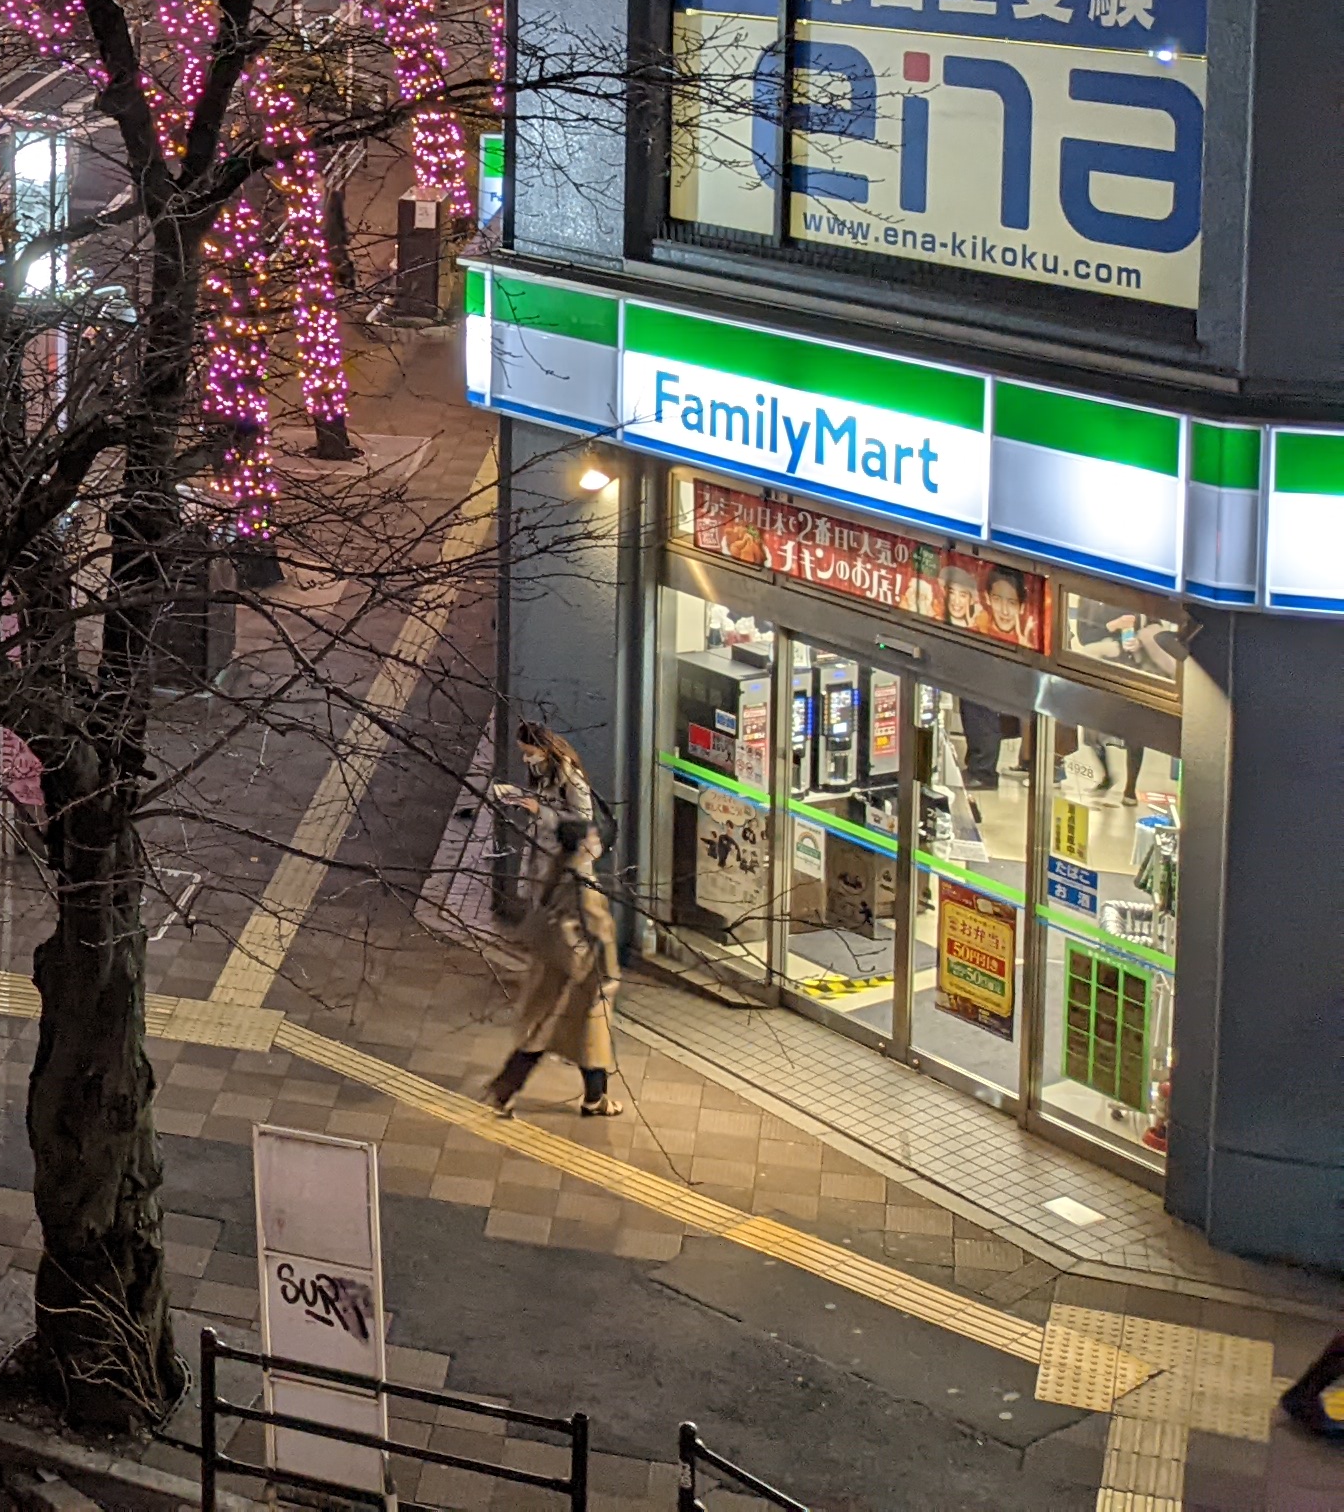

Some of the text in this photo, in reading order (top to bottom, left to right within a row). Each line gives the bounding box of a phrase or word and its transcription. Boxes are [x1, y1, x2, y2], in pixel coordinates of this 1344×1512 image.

[752, 38, 1206, 255] ena
[802, 211, 1143, 290] www.ena-kikoku.com
[654, 368, 939, 494] FamilyMart
[1055, 860, 1091, 885] たばこ
